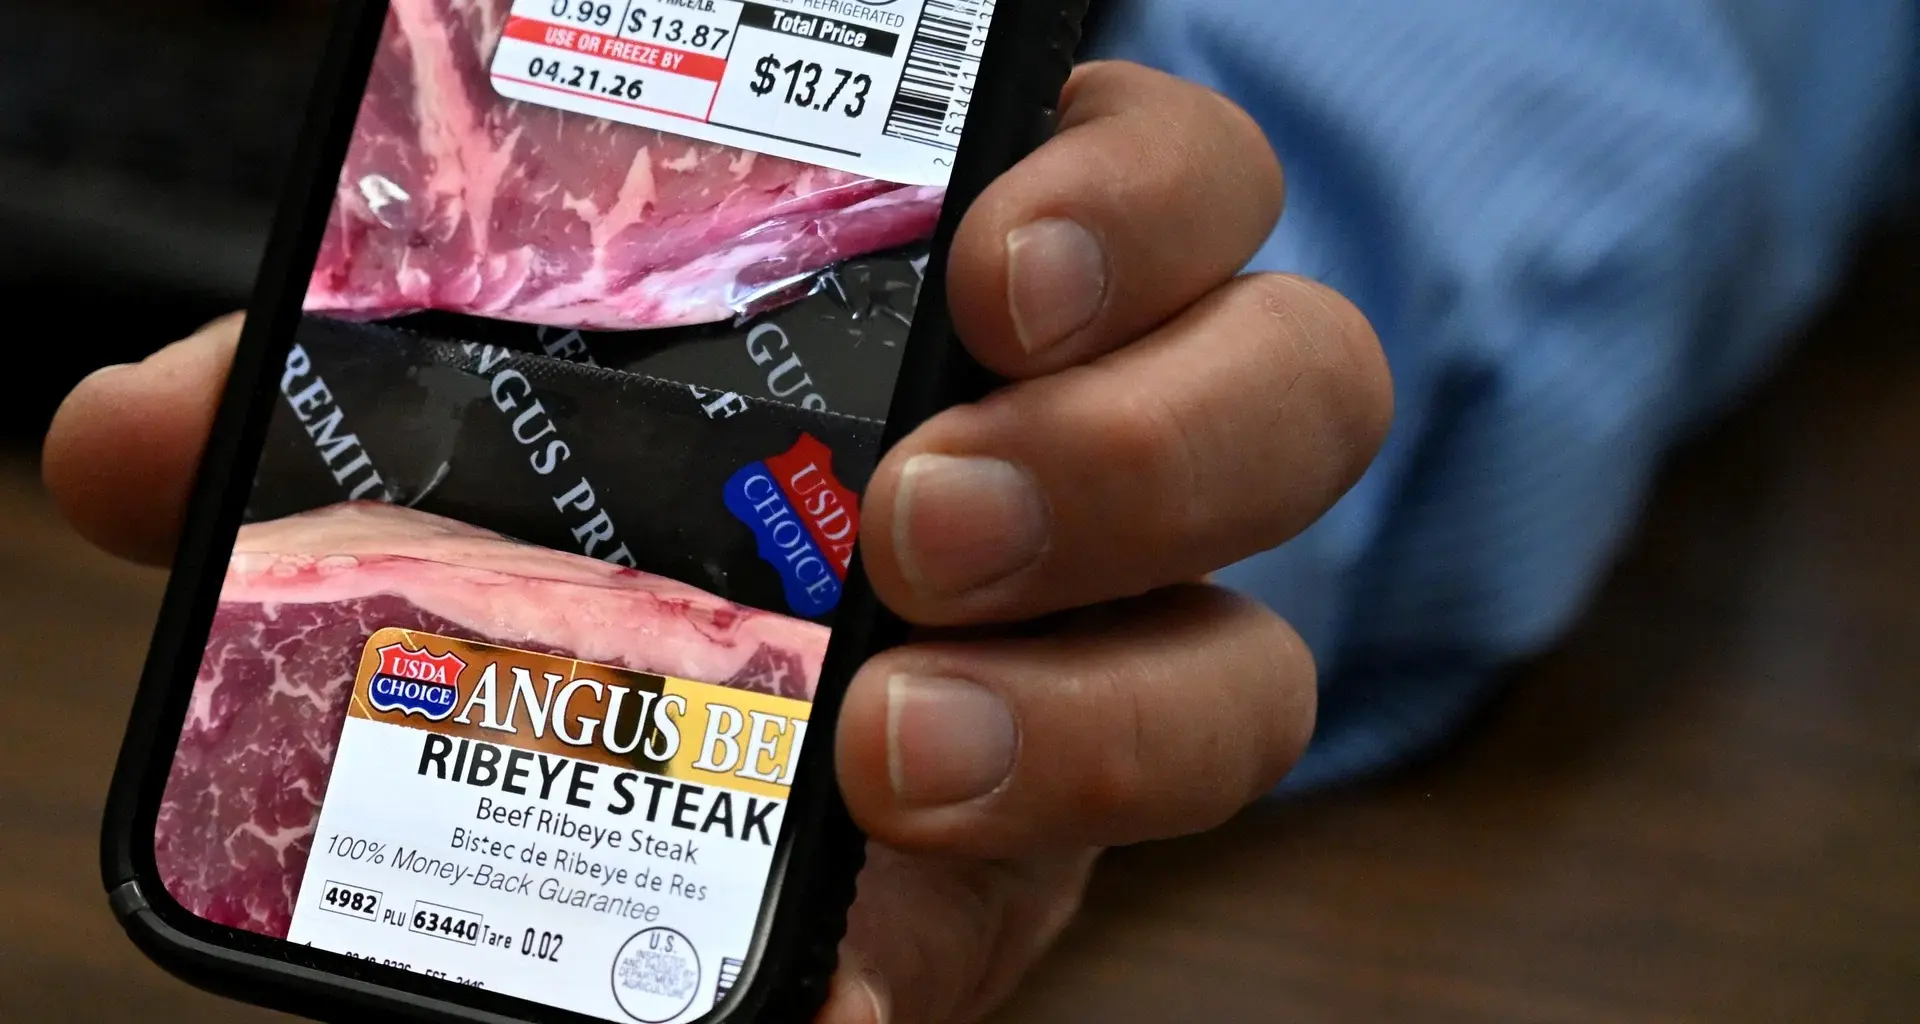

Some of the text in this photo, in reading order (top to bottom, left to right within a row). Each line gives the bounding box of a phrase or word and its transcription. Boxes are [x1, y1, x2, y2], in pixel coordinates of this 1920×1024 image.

[551, 0, 611, 26] 0.99
[627, 8, 729, 51] $13.87
[772, 10, 867, 48] Total Price
[544, 27, 684, 70] USE OR FREEZE BY
[528, 57, 643, 100] 04.21.26
[750, 53, 872, 118] $13.73
[790, 461, 854, 569] USDA
[743, 474, 837, 604] CHOICE
[376, 677, 452, 706] CHOICE
[392, 656, 447, 684] USDA
[453, 662, 686, 762] ANGUS
[417, 733, 780, 846] RIBEYE STEAK
[476, 797, 699, 865] Beef Ribeye Steak
[327, 834, 660, 924] 100% Money-Back Guarantee
[451, 827, 708, 901] Bistec de Ribeye de Res
[325, 886, 377, 914] 4982
[383, 908, 406, 927] PLU
[412, 910, 479, 941] 63440
[481, 925, 564, 962] Tare 0.02
